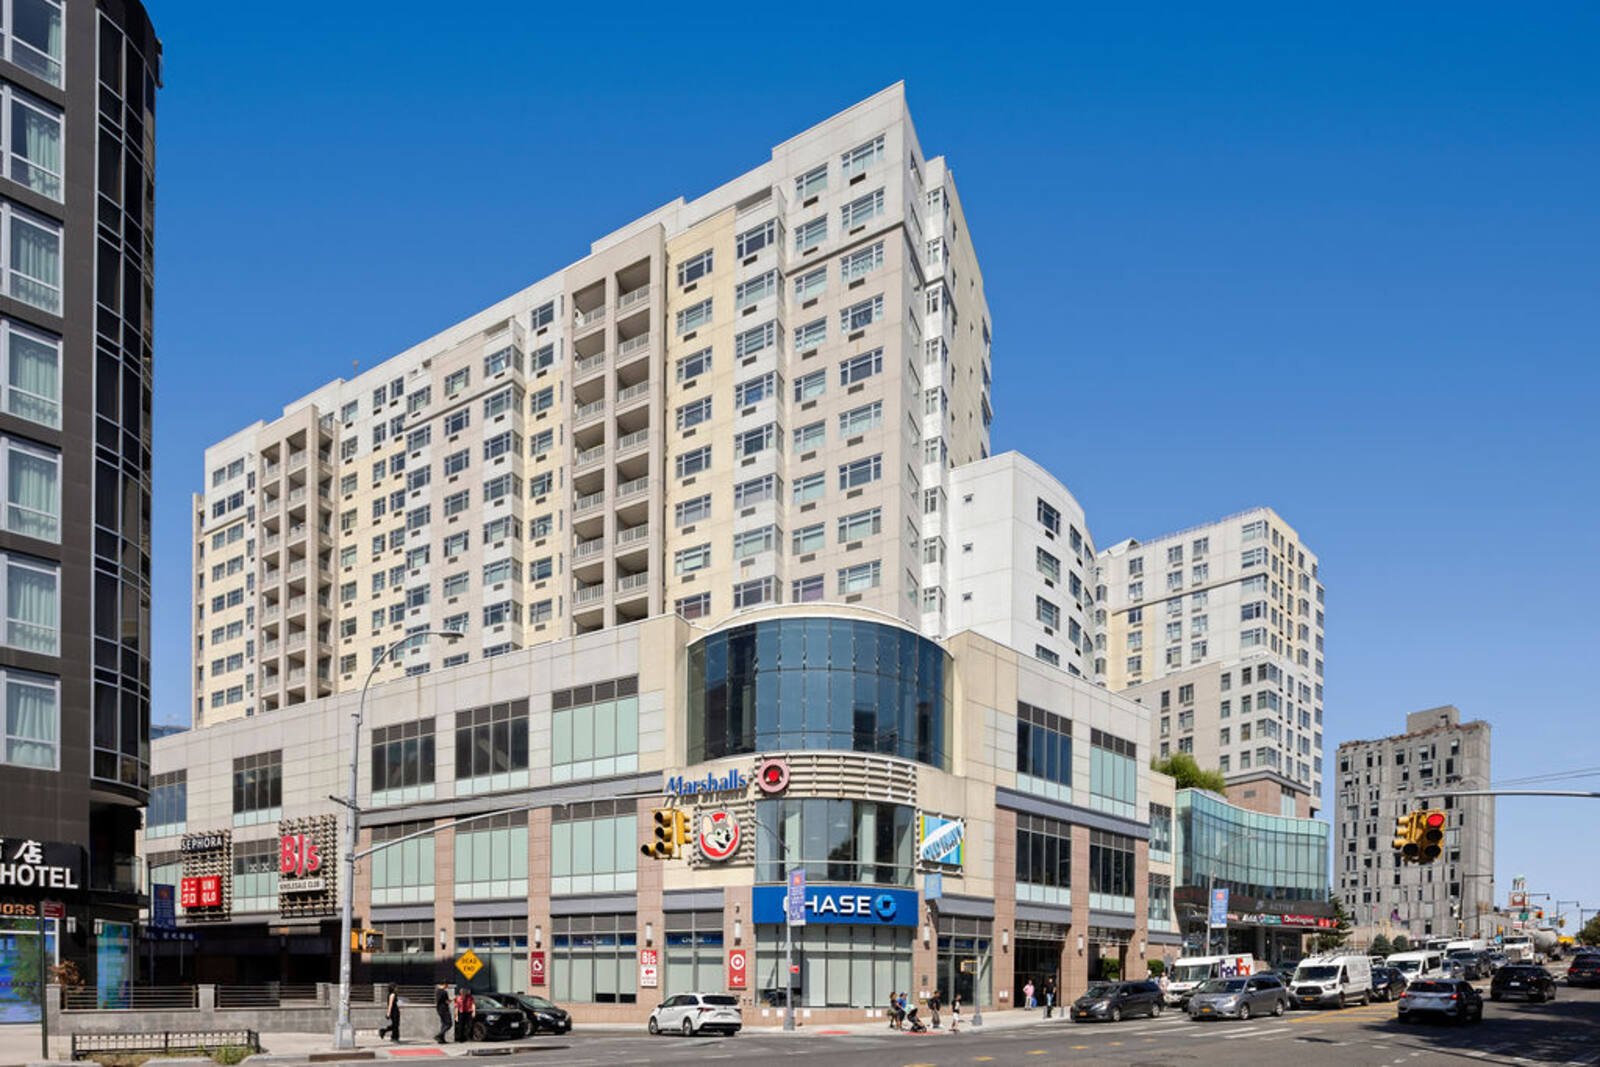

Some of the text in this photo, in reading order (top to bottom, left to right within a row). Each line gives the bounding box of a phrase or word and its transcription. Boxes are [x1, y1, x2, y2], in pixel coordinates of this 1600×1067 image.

[664, 768, 746, 796] Marshalls
[0, 839, 43, 865] 店
[182, 836, 223, 851] SEPHORA
[281, 834, 320, 877] BJ's
[0, 863, 79, 889] HOTEL
[0, 903, 36, 915] ORS
[783, 894, 871, 914] HASE
[1220, 958, 1250, 978] FedEx
